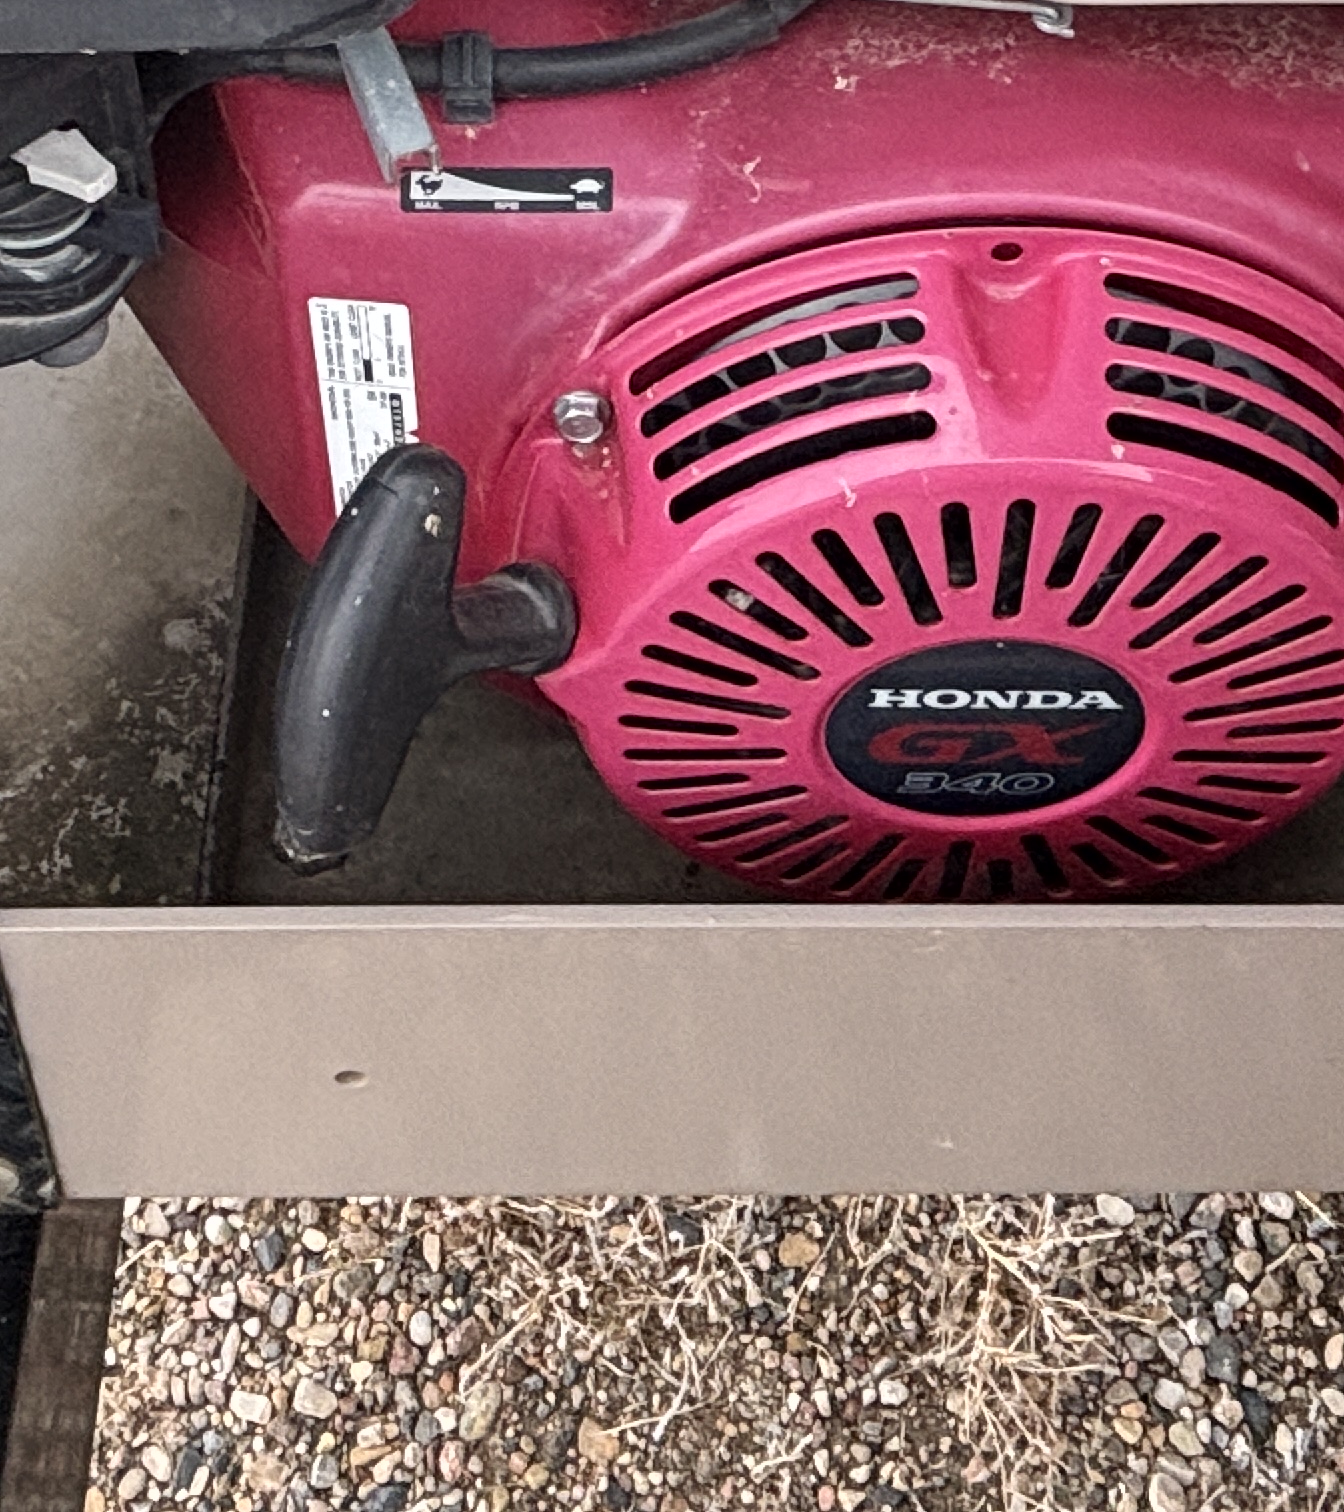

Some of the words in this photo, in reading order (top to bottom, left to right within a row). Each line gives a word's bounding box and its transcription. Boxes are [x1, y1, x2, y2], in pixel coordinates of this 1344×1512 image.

[867, 688, 1124, 710] HONDA
[867, 719, 1114, 767] GX
[896, 771, 1055, 796] 340
